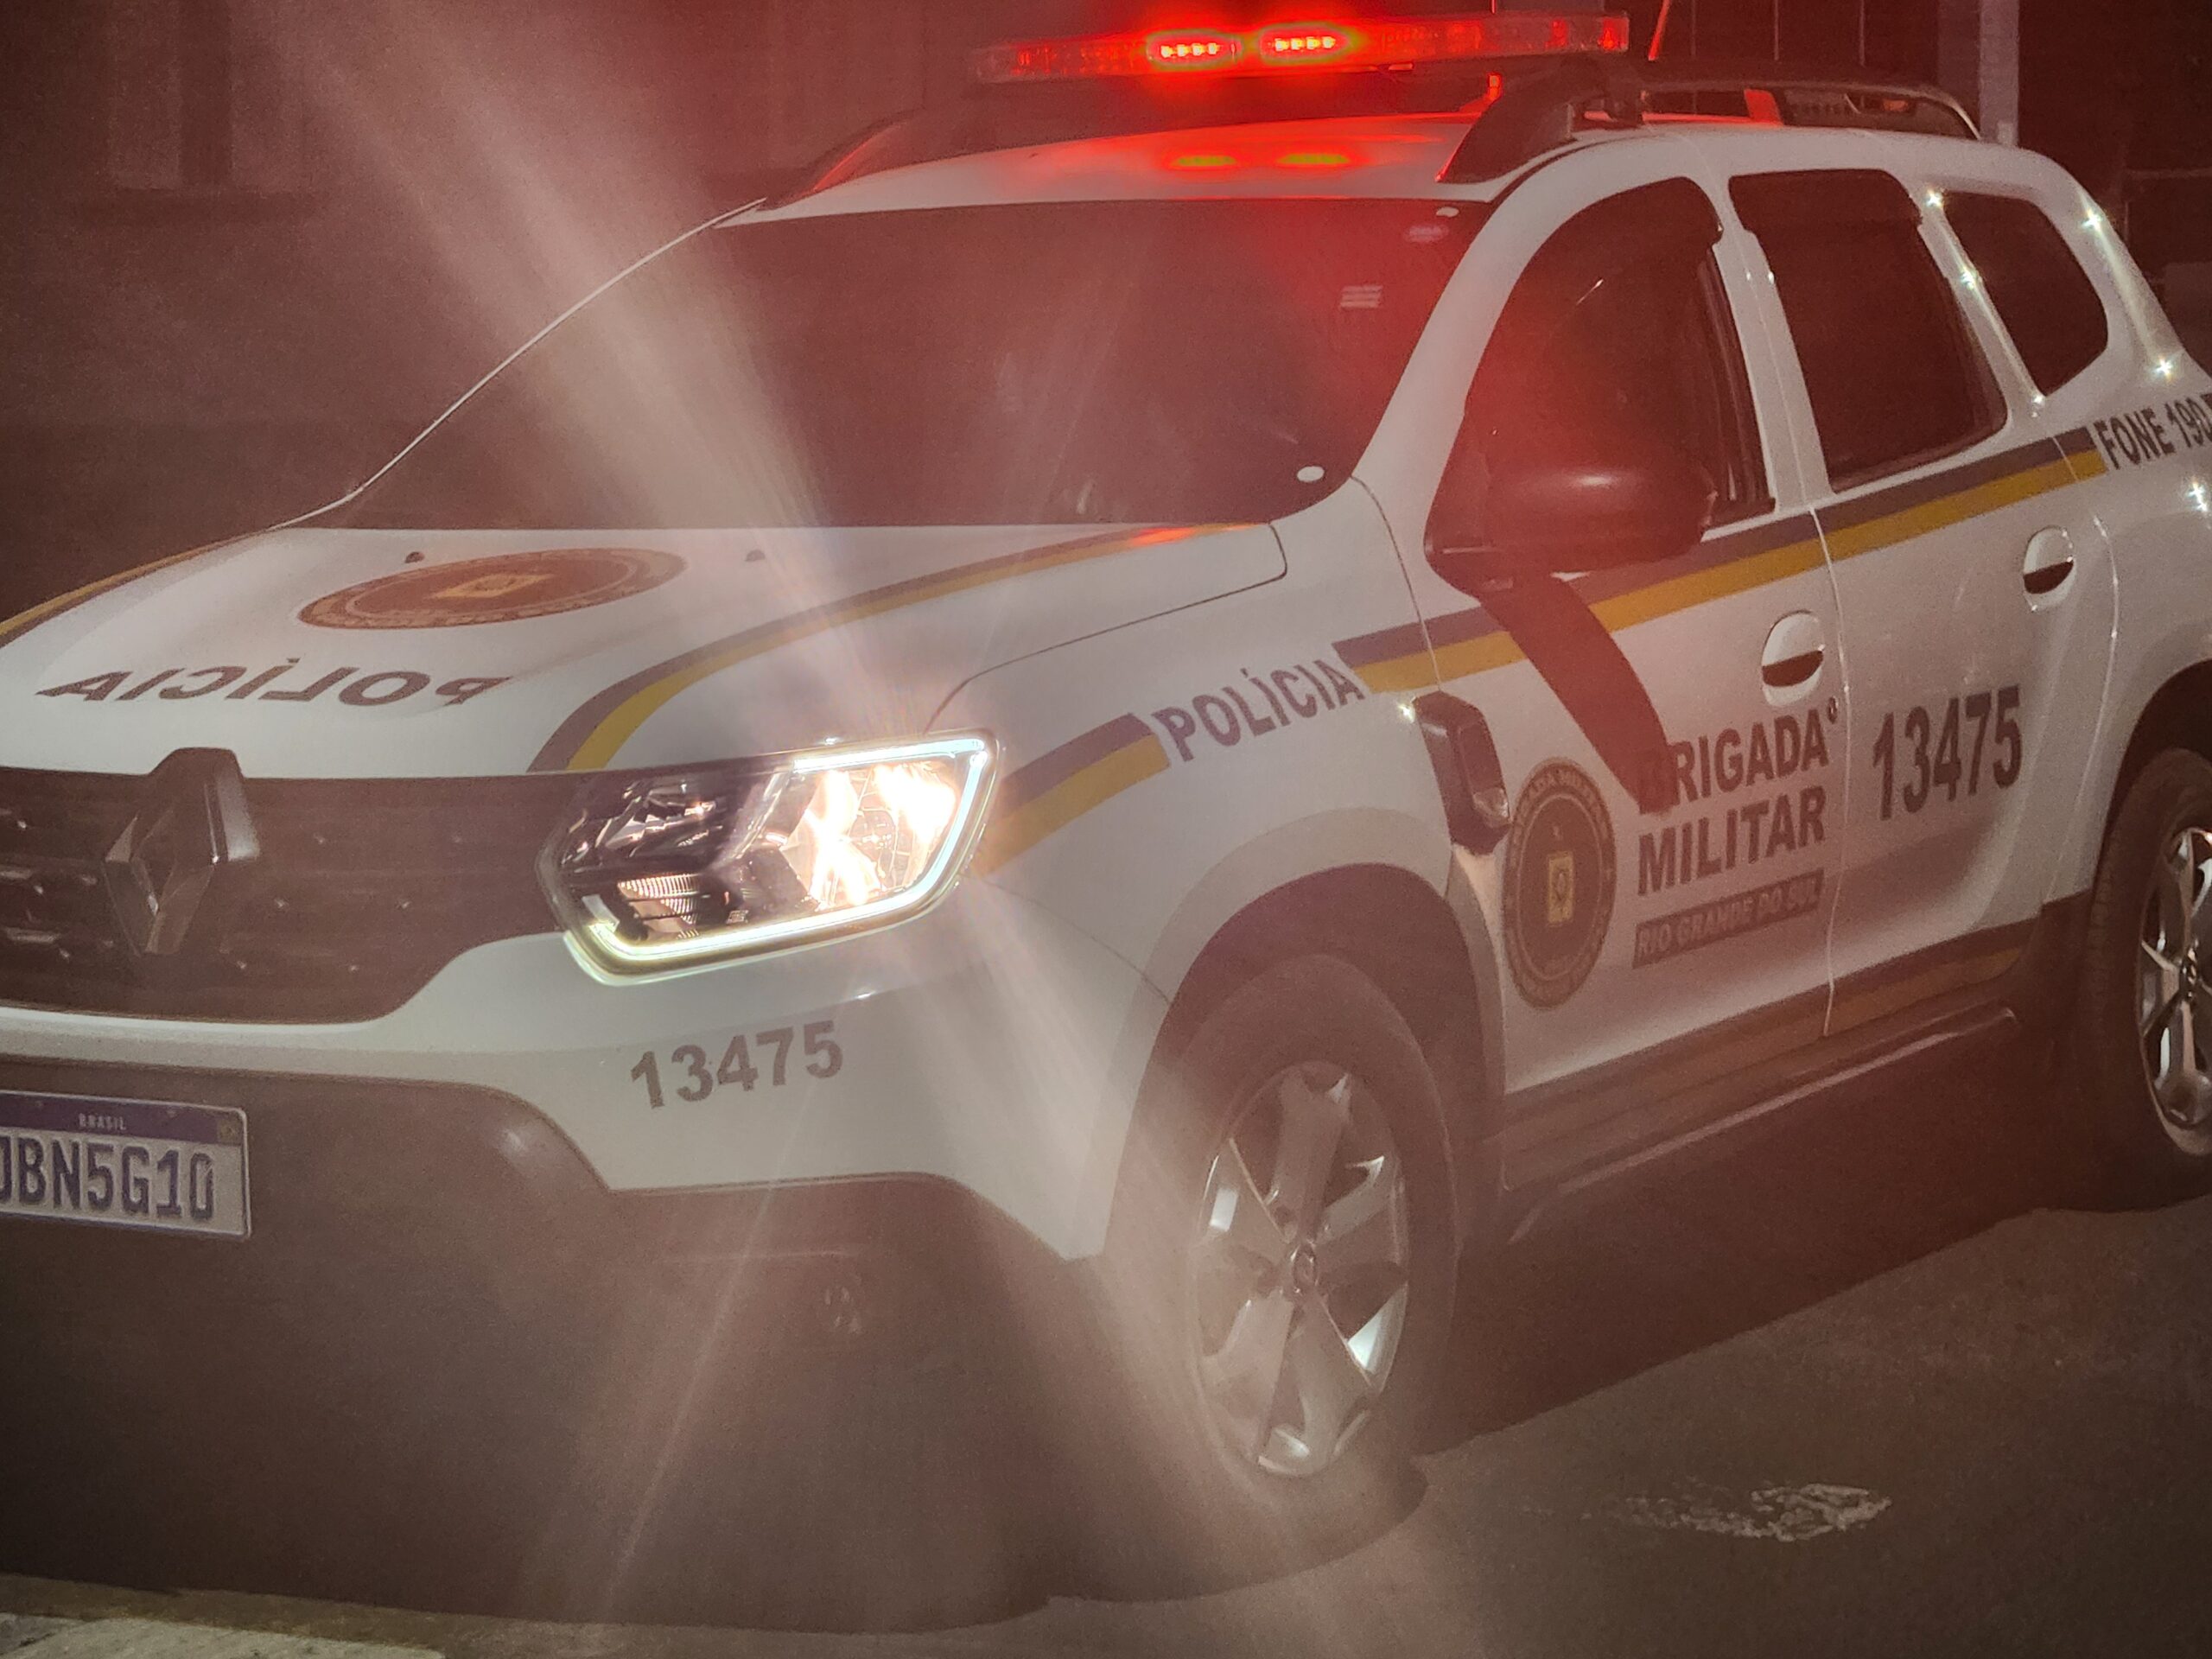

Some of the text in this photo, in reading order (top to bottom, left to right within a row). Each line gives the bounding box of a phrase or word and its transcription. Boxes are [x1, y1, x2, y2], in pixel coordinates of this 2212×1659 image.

[2094, 397, 2212, 470] FONE 190
[1637, 709, 1829, 810] RIGADA
[1872, 683, 2023, 820] 13475
[1638, 785, 1827, 896] MILITAR
[1638, 923, 1673, 954] RIO
[630, 1020, 843, 1109] 13475
